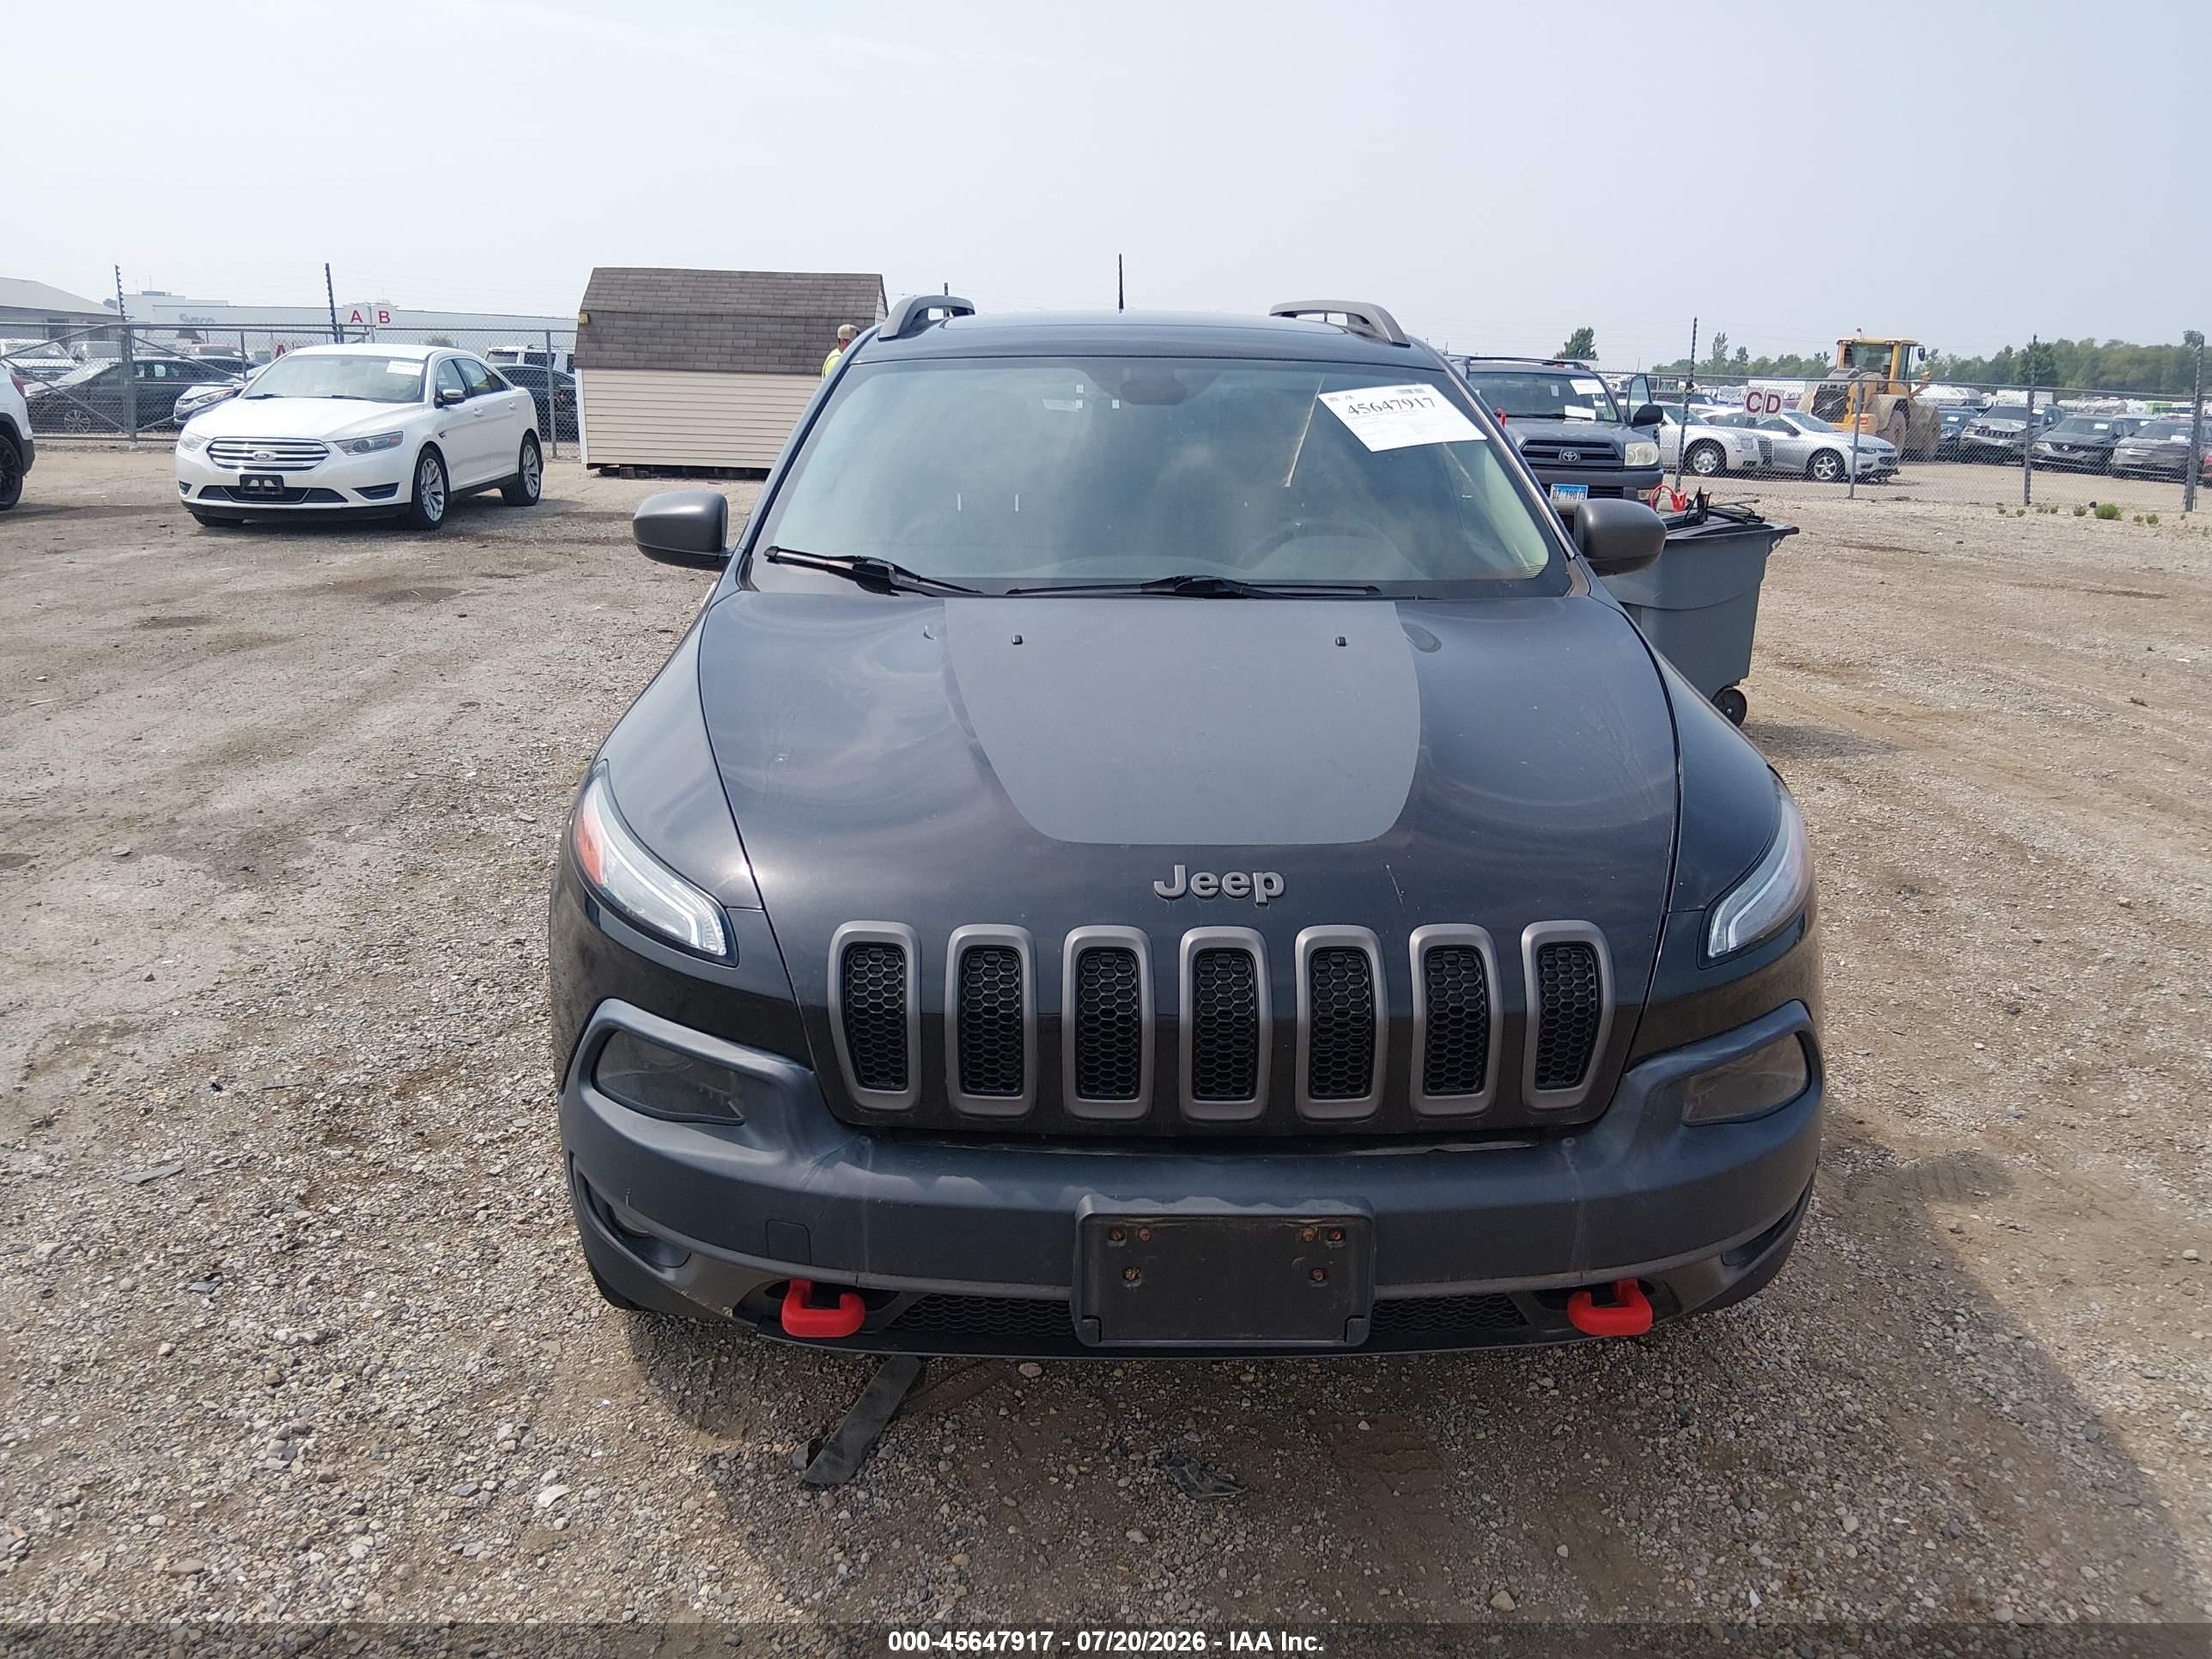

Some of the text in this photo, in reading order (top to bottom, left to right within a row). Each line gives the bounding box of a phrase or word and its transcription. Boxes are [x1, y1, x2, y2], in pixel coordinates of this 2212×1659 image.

[349, 309, 363, 324] A
[378, 310, 391, 324] B
[1347, 397, 1436, 416] 45647917
[1746, 391, 1763, 414] C
[1765, 393, 1782, 414] D
[1153, 864, 1285, 904] Jeep
